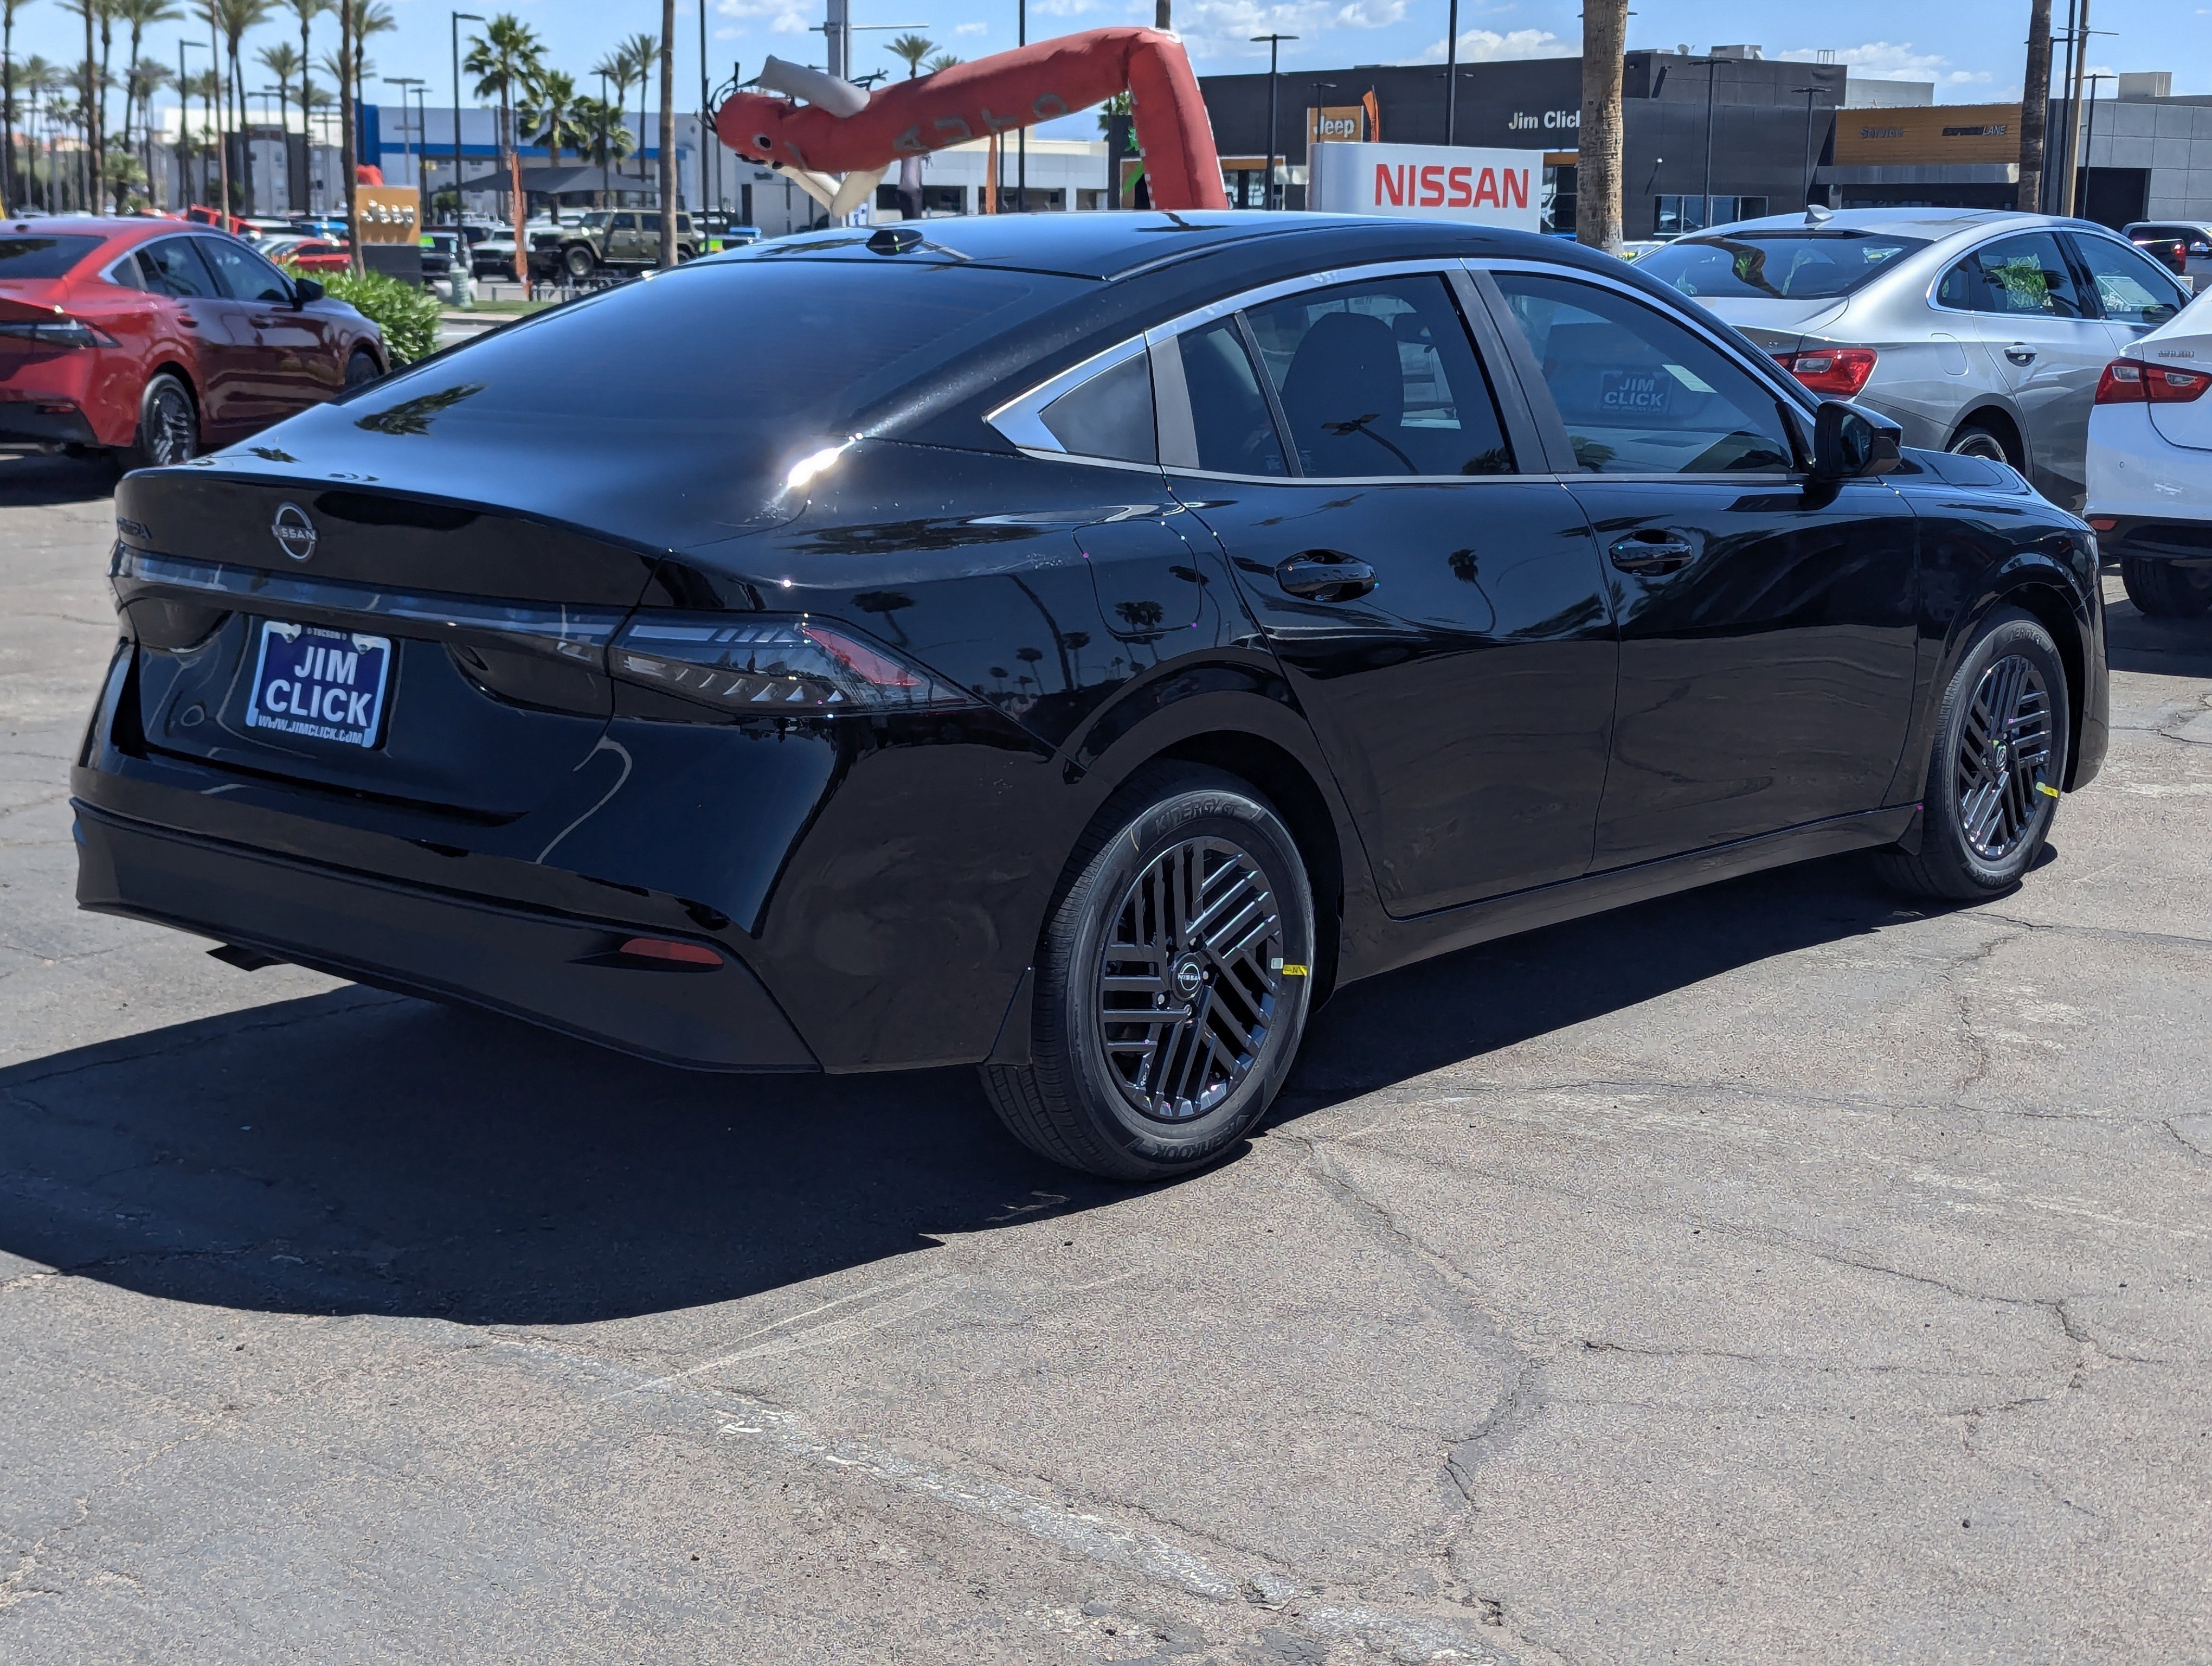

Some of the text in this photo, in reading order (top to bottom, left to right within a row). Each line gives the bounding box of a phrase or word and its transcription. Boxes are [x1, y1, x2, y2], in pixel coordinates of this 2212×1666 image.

[1313, 115, 1354, 138] Jeep
[1508, 112, 1539, 130] Jim
[1375, 164, 1529, 209] NISSAN
[1619, 379, 1655, 392] JIM
[1604, 391, 1664, 407] CLICK
[272, 526, 316, 541] NSSAN
[294, 645, 358, 685] JIM
[266, 679, 372, 727] CLICK
